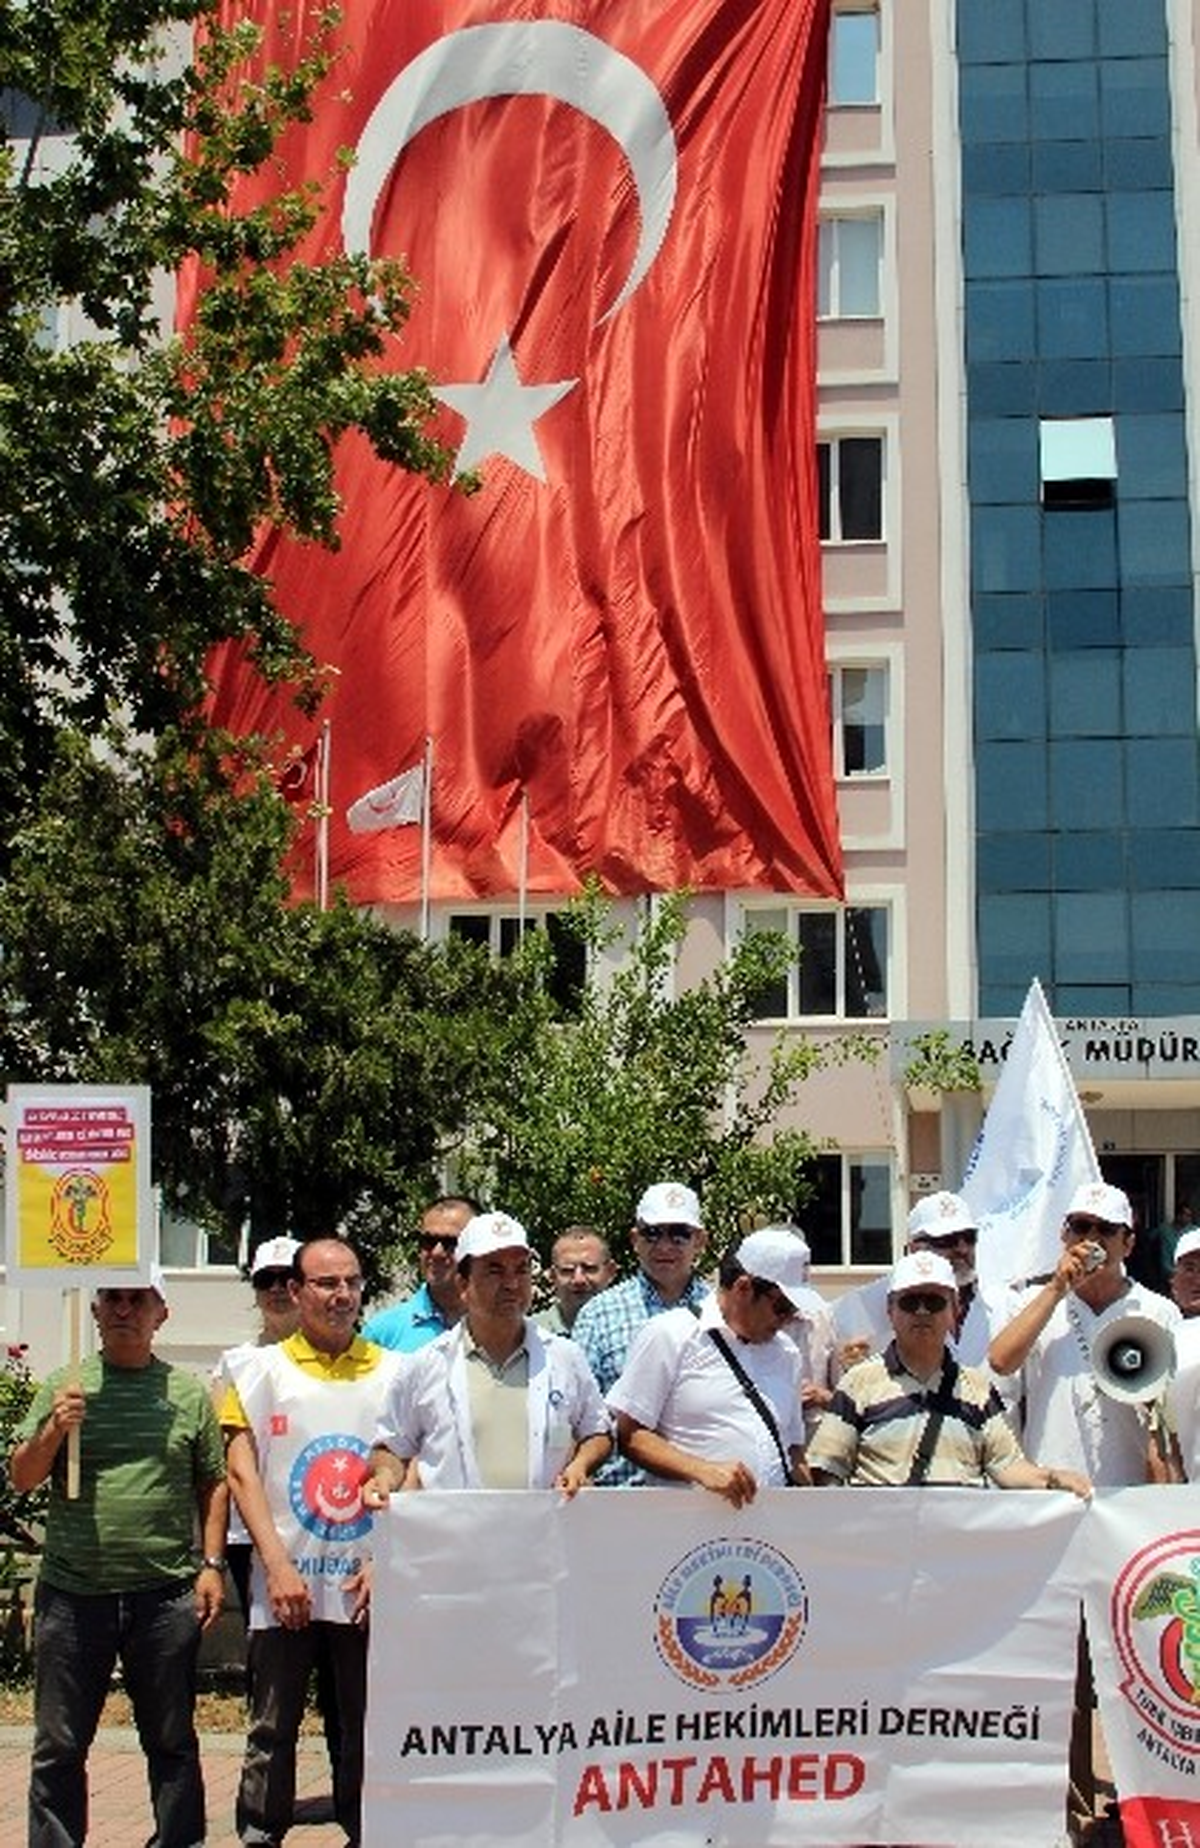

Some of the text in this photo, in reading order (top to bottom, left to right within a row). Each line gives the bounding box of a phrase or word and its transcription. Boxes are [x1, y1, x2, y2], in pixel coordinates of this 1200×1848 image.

[400, 1700, 1040, 1757] ANTALYA AİLE HEKİMLERİ DERNEĞİ
[1137, 1728, 1195, 1775] ANTALYA
[573, 1754, 866, 1817] ANTAHED
